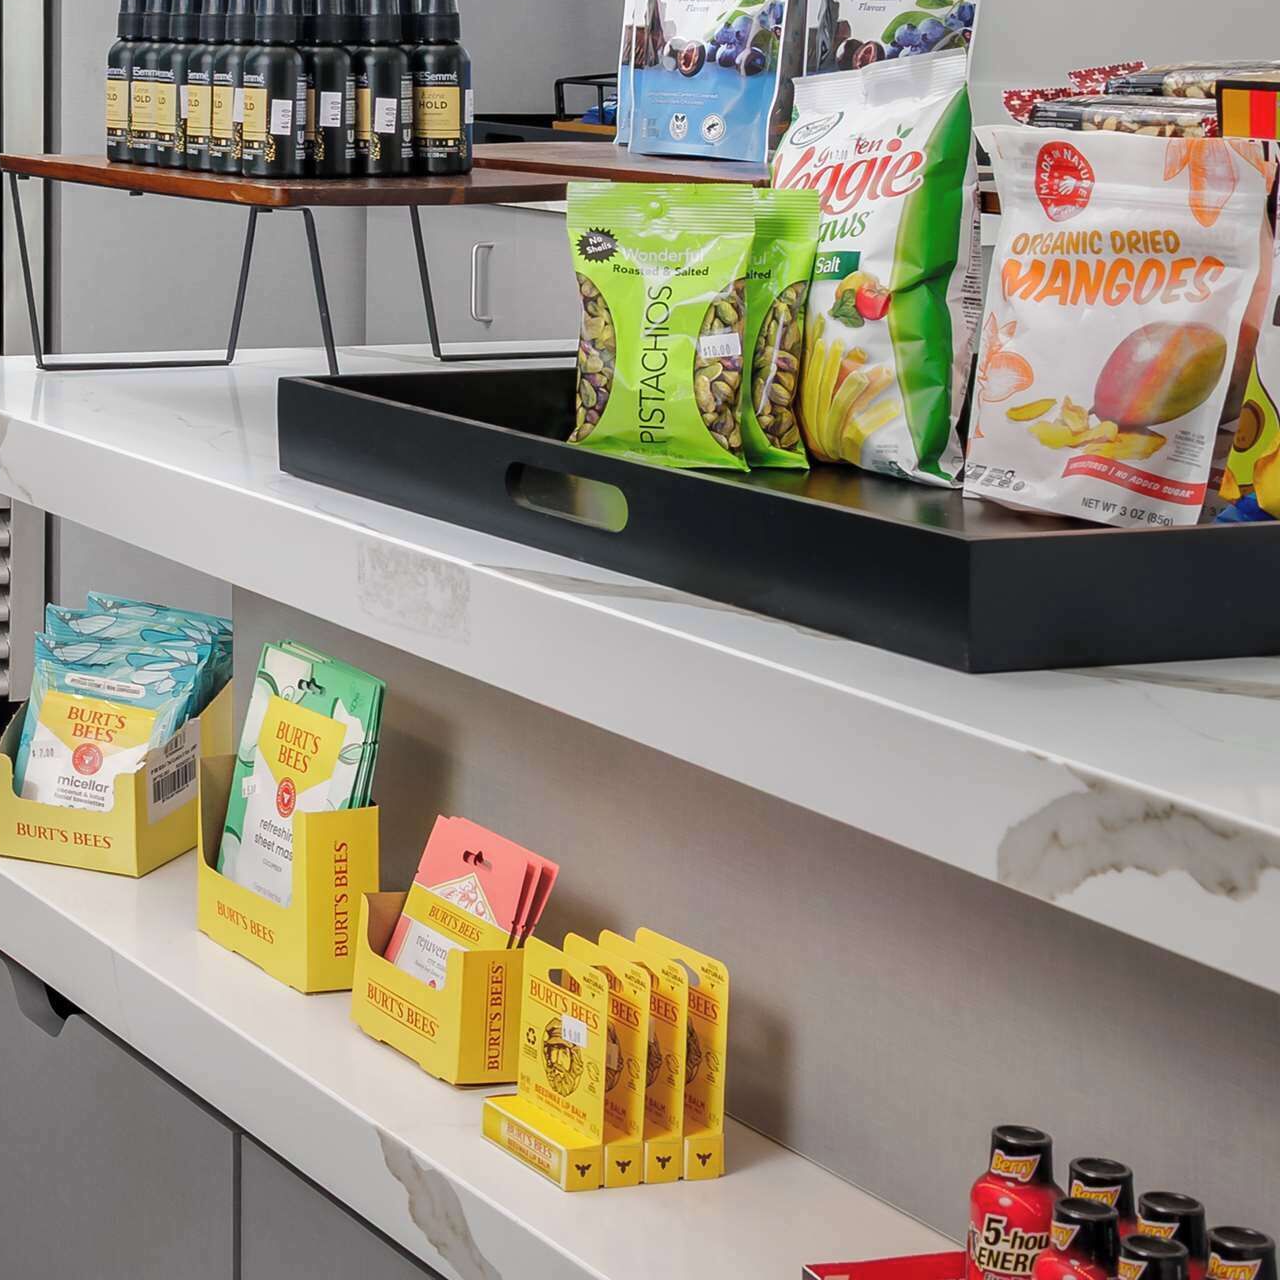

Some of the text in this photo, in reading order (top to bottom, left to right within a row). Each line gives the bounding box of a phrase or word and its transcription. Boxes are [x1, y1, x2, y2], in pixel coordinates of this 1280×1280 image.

[858, 3, 886, 13] Flavors
[419, 100, 448, 109] HOLD
[773, 146, 924, 215] Veggie
[1040, 149, 1093, 200] MADE NATURE
[585, 242, 613, 254] Shells
[589, 234, 603, 245] No
[1011, 230, 1181, 255] ORGANIC DRIED
[623, 248, 705, 262] Wonderful
[816, 255, 840, 273] Salt
[613, 264, 709, 276] Roasted & Salted
[1001, 255, 1225, 306] MANGOES
[703, 343, 731, 357] $10.00
[639, 285, 673, 444] PISTACHIOS
[1115, 469, 1160, 491] NO ADDED
[1081, 496, 1144, 519] NET WT 3 OZ
[67, 705, 127, 730] BURT'S
[71, 722, 115, 743] BEES
[275, 720, 322, 755] BURT'S
[277, 744, 311, 774] BEES
[57, 775, 110, 794] micellar
[16, 821, 114, 850] BURT'S BEES
[253, 832, 275, 851] sheet
[334, 841, 348, 958] BURT'S BEES
[217, 899, 275, 945] BURT'S BEES
[428, 904, 482, 943] BURT'S BEES
[582, 974, 606, 993] NATURAL
[623, 972, 647, 990] NATURAL
[660, 968, 684, 985] NATURAL
[700, 965, 725, 983] NATURAL
[367, 982, 438, 1038] BURT'S BEES
[529, 978, 600, 1031] BURT'S BEES
[611, 998, 640, 1027] BEES
[650, 995, 678, 1023] BEES
[689, 993, 719, 1020] BEES
[487, 964, 504, 1071] BURT'S BEES
[560, 1097, 588, 1121] LIP BALM
[608, 1101, 627, 1117] BALM
[506, 1122, 554, 1160] BURT'S BEES
[992, 1151, 1037, 1178] Berry
[1071, 1182, 1120, 1206] Berry
[1209, 1256, 1255, 1280] Berry
